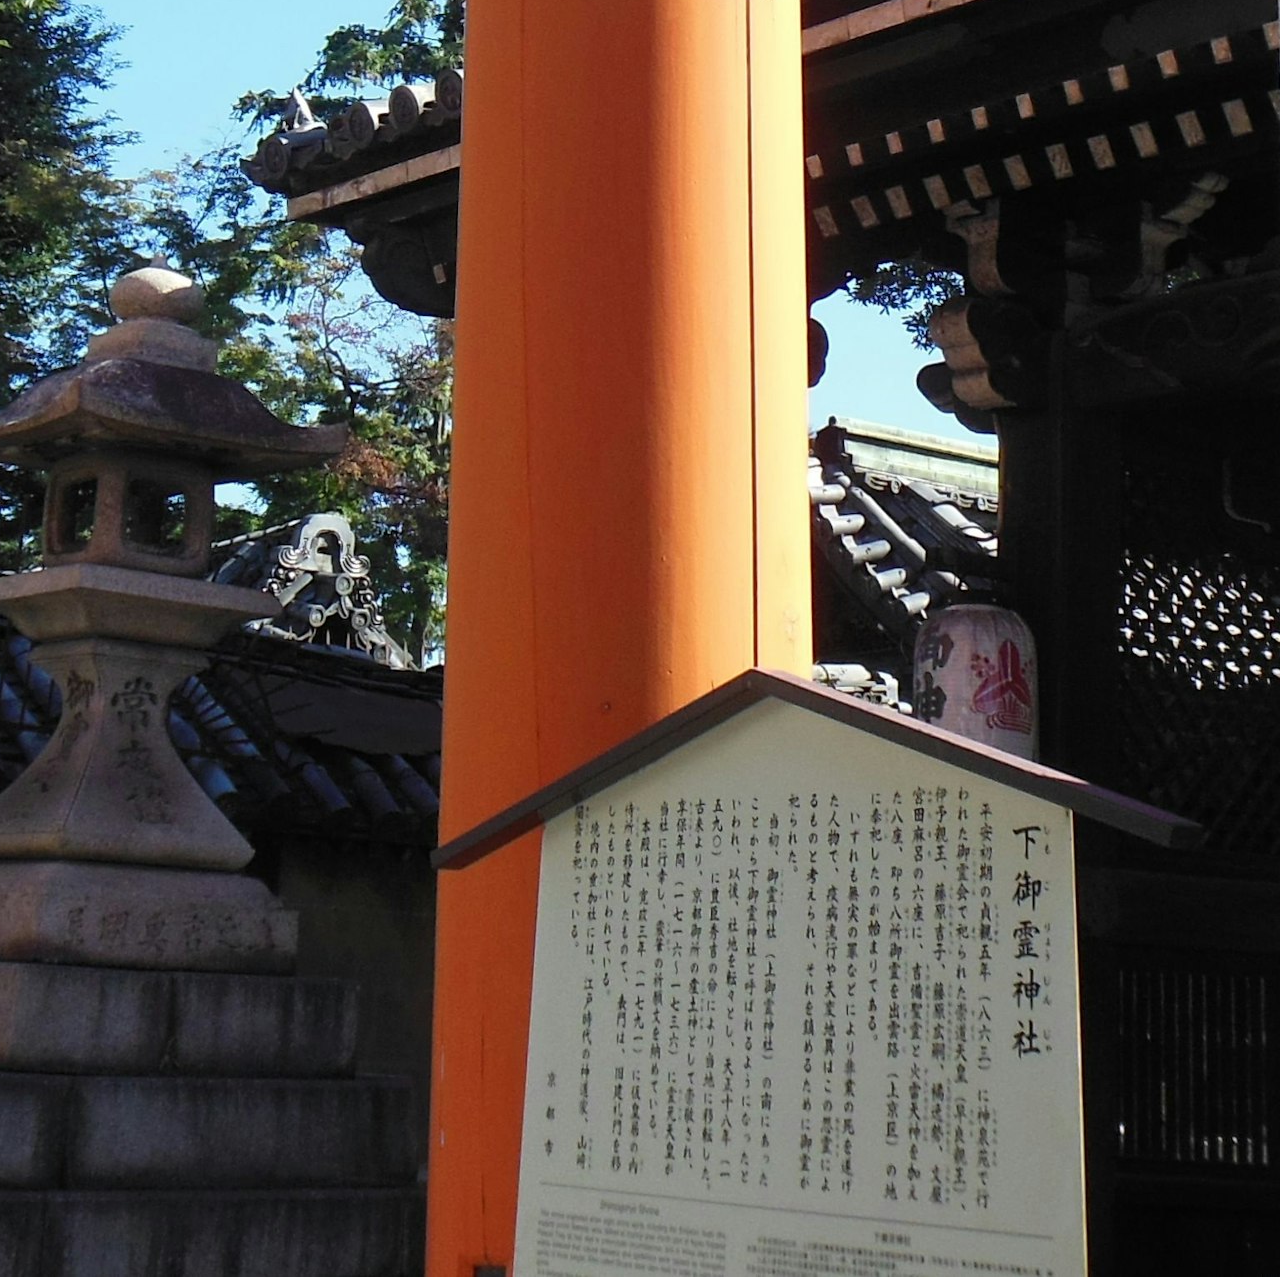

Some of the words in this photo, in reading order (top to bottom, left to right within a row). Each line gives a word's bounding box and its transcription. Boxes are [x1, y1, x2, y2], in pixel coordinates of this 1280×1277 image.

[1012, 825, 1042, 1059] 下御霊神社
